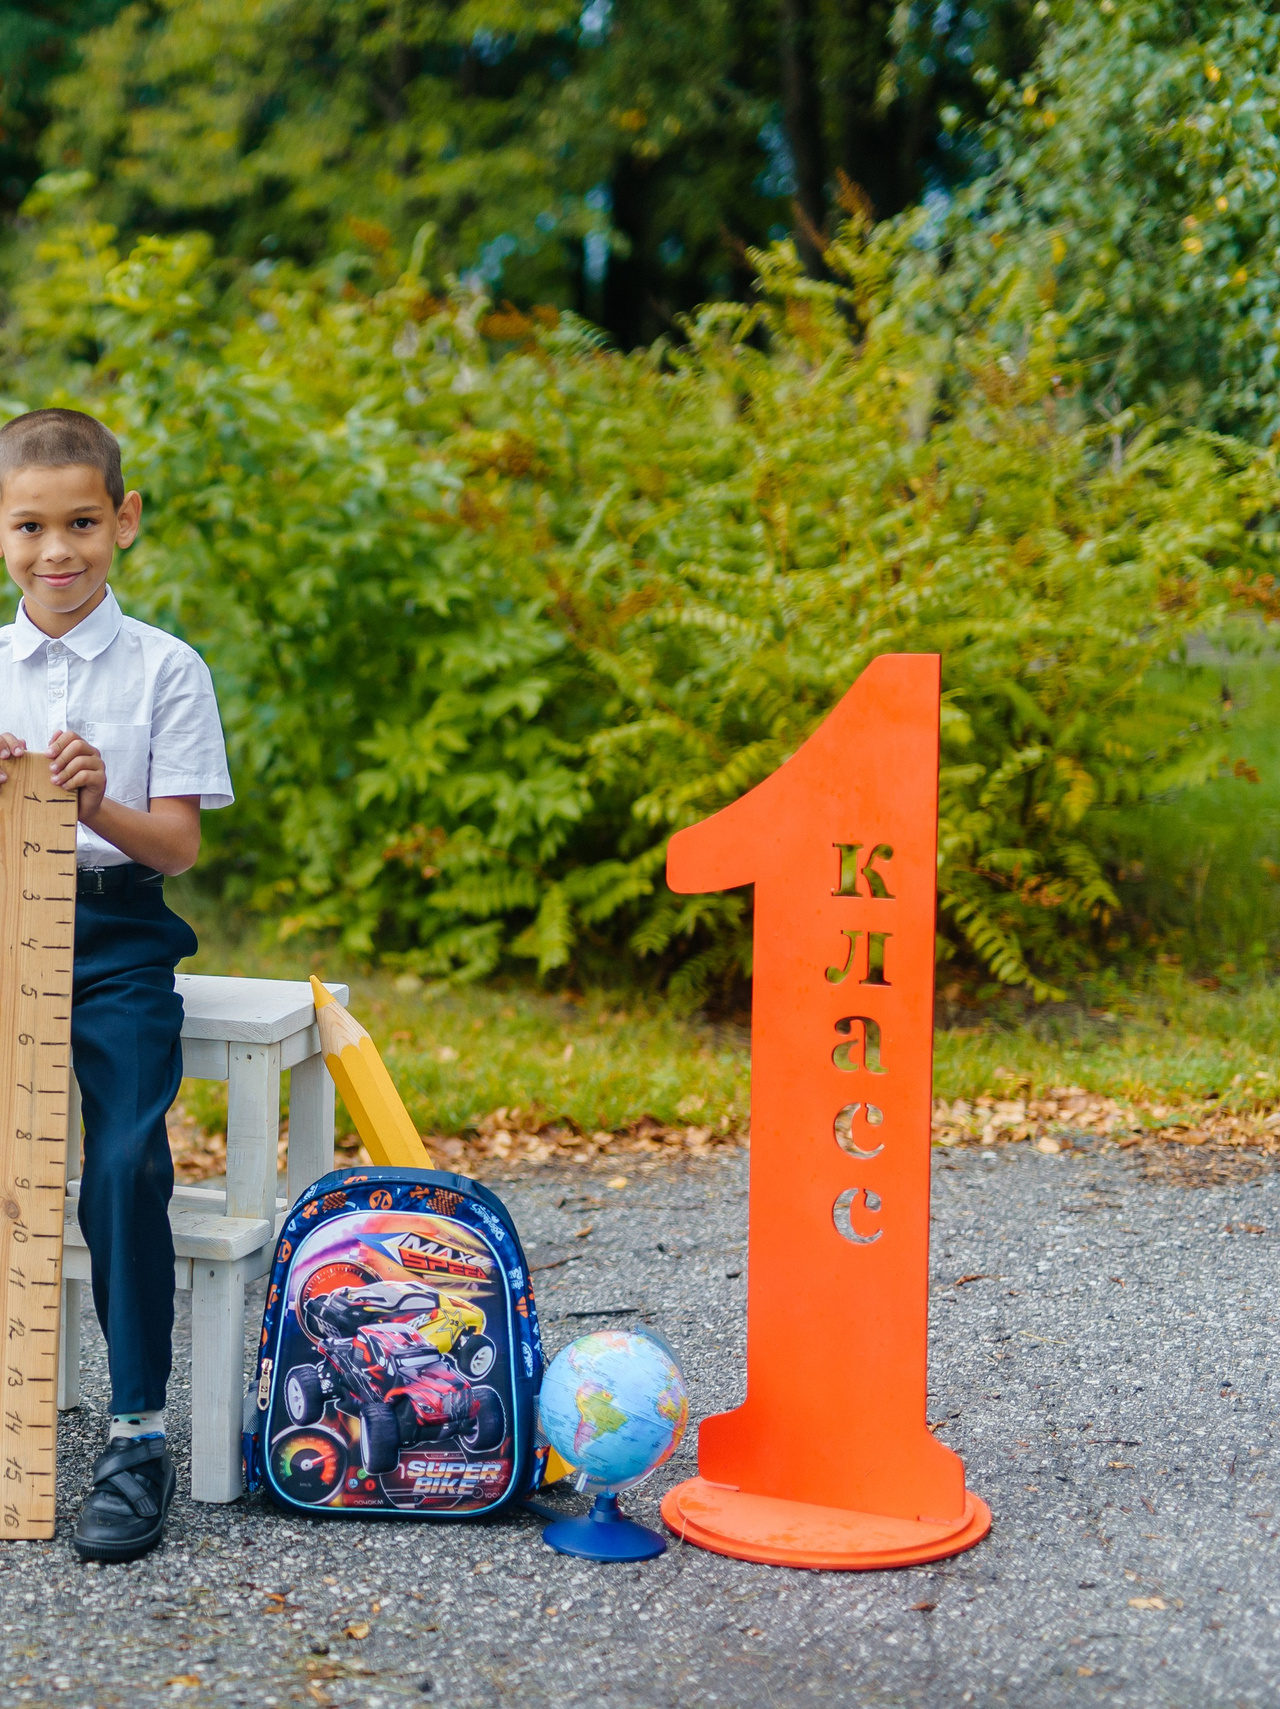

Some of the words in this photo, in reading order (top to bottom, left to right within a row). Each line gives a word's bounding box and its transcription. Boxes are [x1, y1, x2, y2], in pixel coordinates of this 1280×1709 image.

[23, 792, 42, 804] 1
[23, 840, 41, 857] 2
[22, 888, 41, 901] 3
[20, 937, 39, 951] 4
[20, 984, 38, 999] 5
[18, 1032, 35, 1046] 6
[16, 1083, 33, 1094] 7
[15, 1128, 32, 1141] 8
[14, 1177, 31, 1190] 9
[12, 1220, 29, 1243] 10
[9, 1266, 26, 1290] 11
[9, 1317, 26, 1340] 12
[7, 1366, 24, 1388] 13
[5, 1410, 23, 1436] 14
[3, 1456, 23, 1483] 15
[406, 1460, 502, 1480] SUPER
[412, 1477, 479, 1495] BIKE
[4, 1503, 21, 1529] 16
